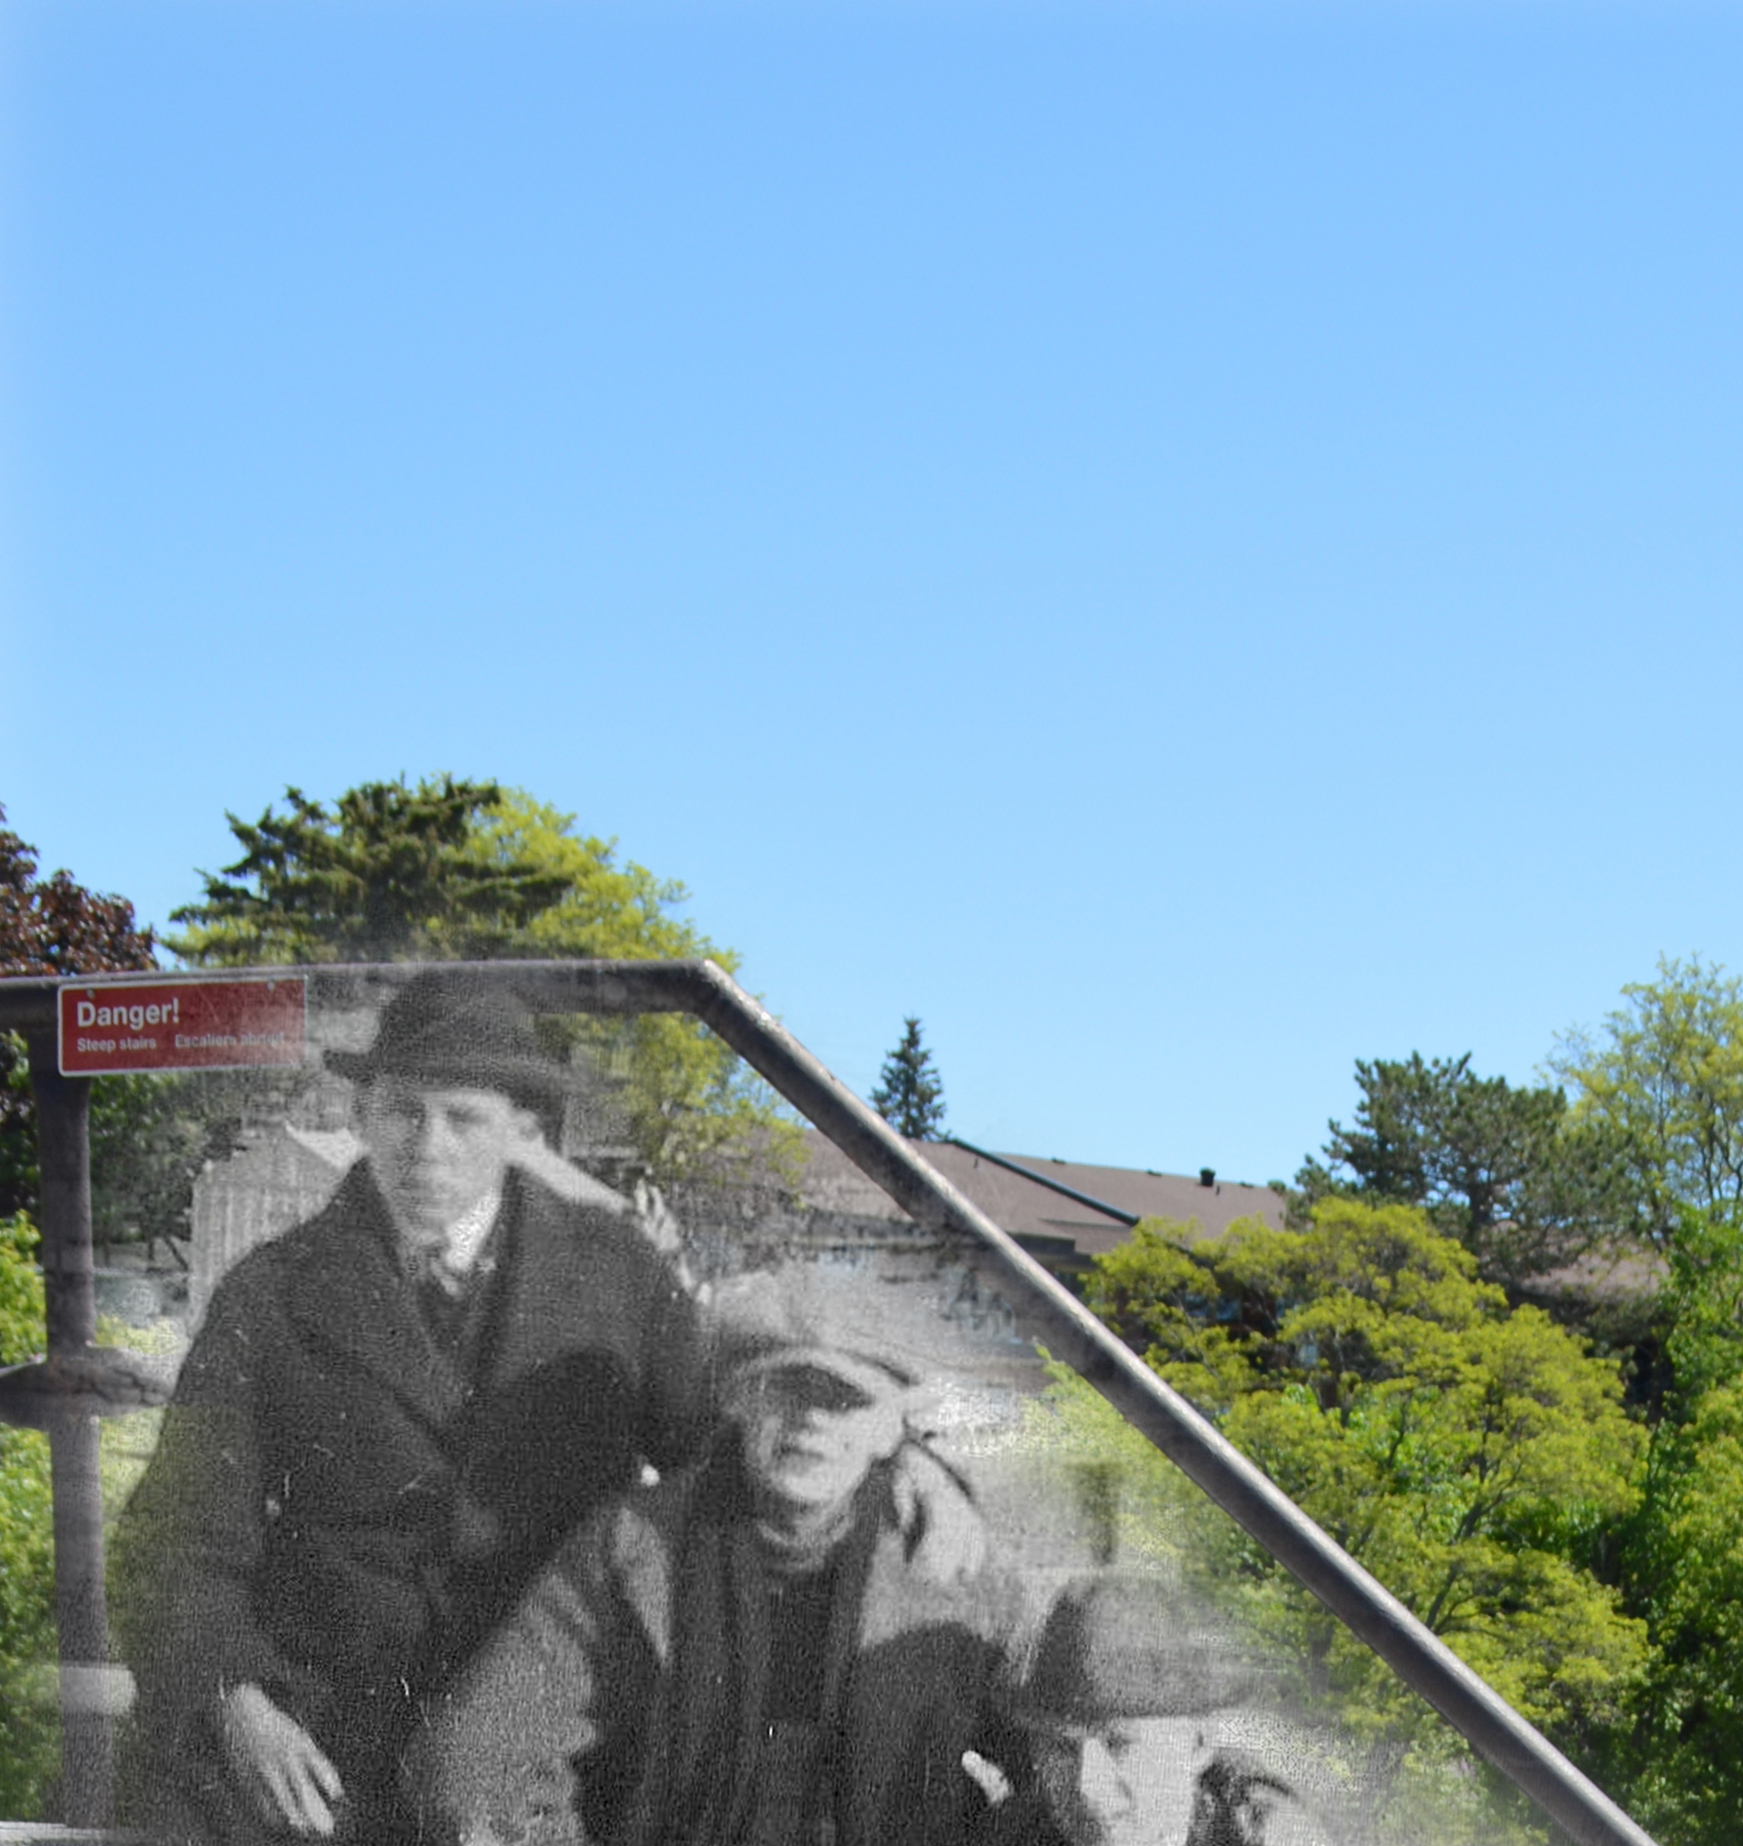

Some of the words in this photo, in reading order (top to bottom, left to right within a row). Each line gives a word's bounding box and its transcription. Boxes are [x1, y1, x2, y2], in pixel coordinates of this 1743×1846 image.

[77, 998, 179, 1031] Danger!
[77, 1038, 116, 1054] Steep
[119, 1036, 157, 1050] stairs
[175, 1033, 237, 1049] Escaliers
